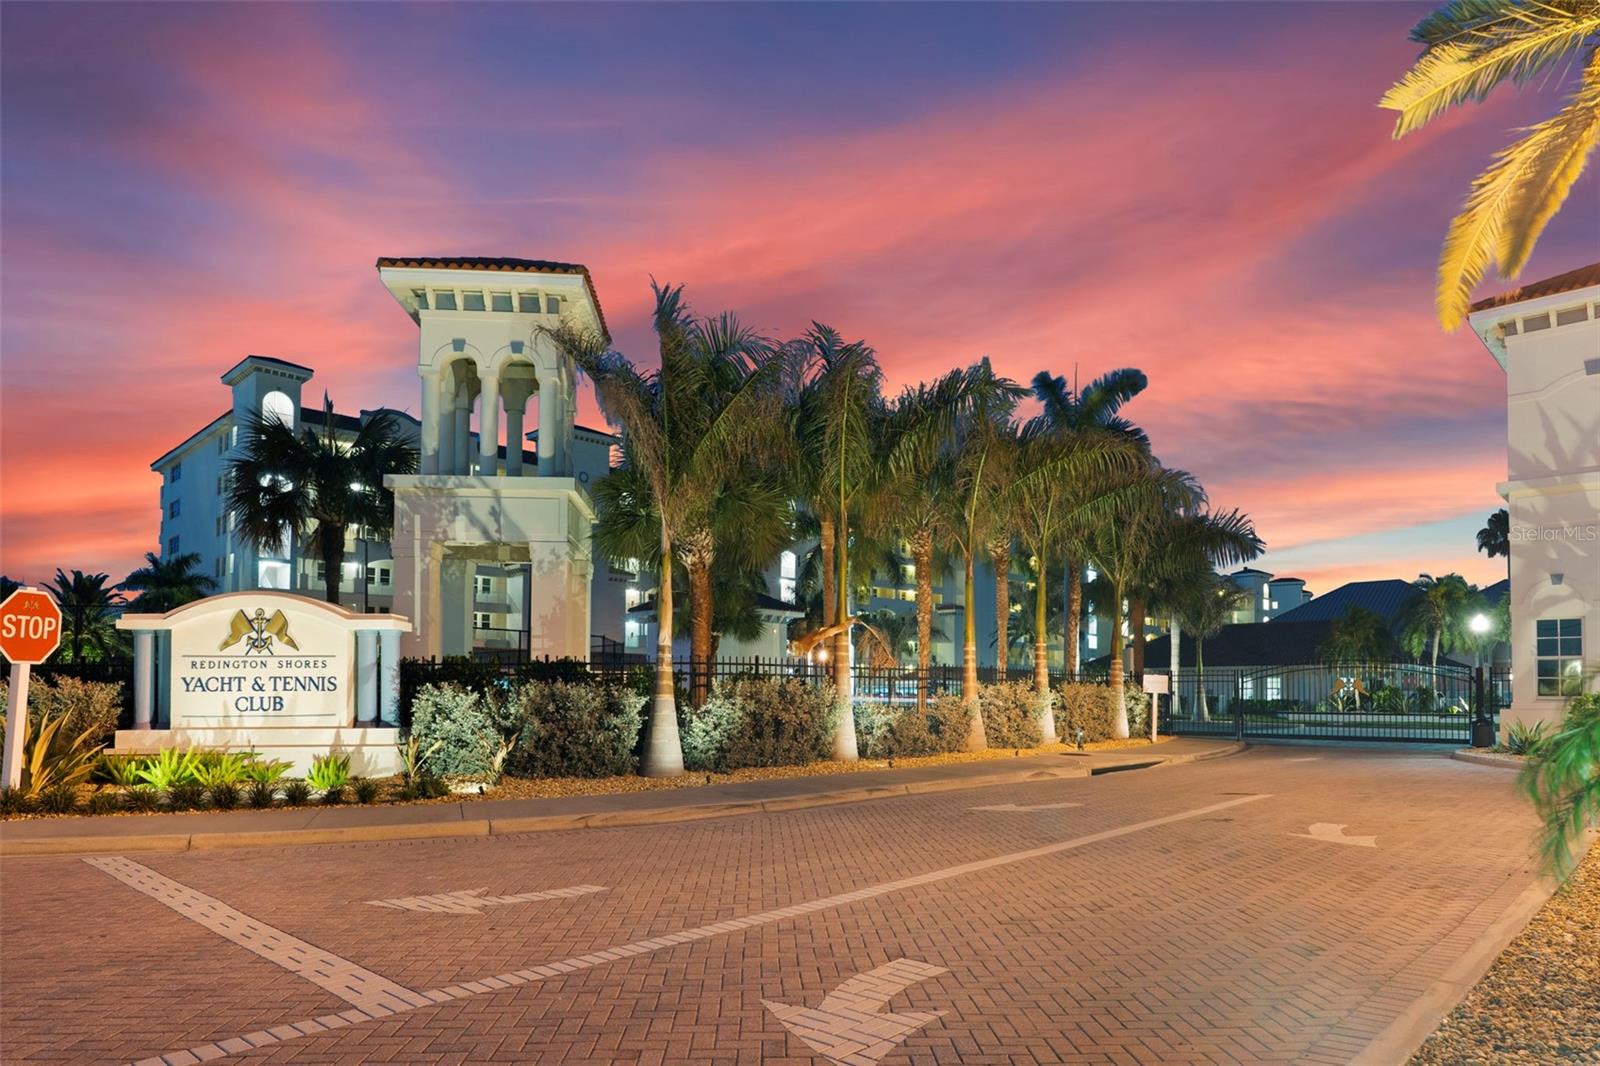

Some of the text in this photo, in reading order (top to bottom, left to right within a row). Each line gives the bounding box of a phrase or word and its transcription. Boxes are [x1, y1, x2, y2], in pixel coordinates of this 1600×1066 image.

[2, 613, 56, 639] STOP
[191, 660, 328, 669] REDINGTON SHORES
[181, 676, 337, 692] YACHT & TENNIS
[235, 696, 284, 712] CLUB
